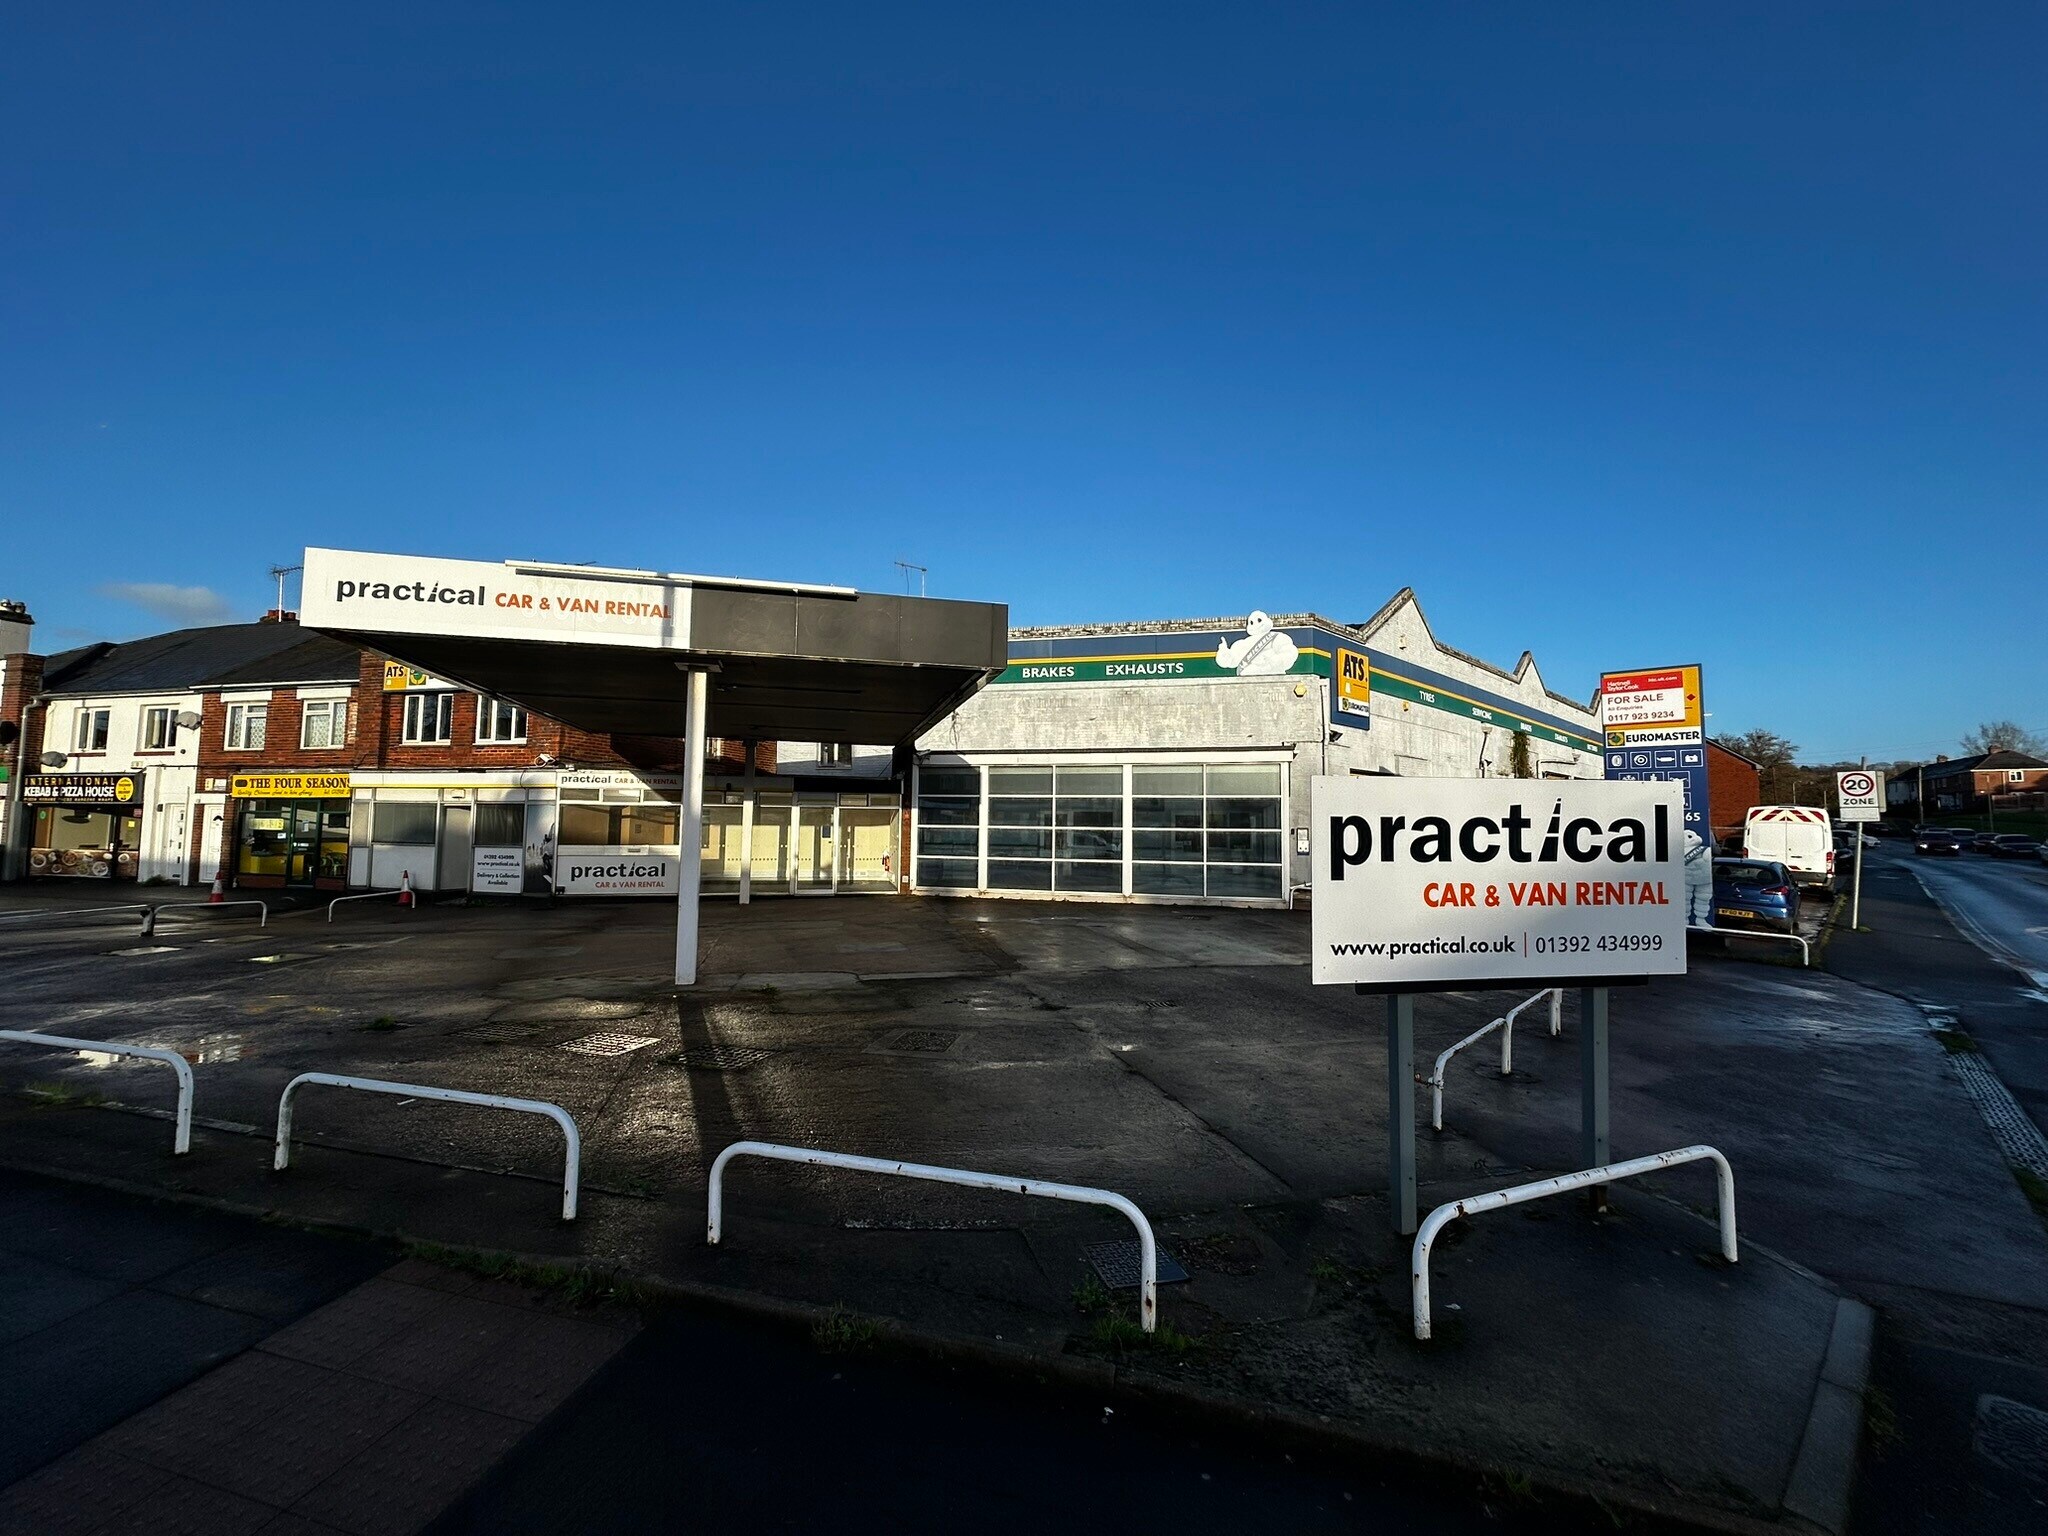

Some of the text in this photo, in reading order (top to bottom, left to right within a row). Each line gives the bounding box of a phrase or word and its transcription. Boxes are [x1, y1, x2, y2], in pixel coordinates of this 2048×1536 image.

[336, 579, 672, 620] practical CAR & VAN RENTAL
[1022, 662, 1185, 679] BRAKES EXHAUSTS
[1419, 690, 1436, 704] TYRES
[1607, 693, 1665, 705] FOR SALE
[1608, 710, 1675, 722] 0117 923 9234
[1626, 731, 1700, 743] EUROMASTER
[24, 777, 115, 786] INTERNATIONAL
[249, 778, 271, 788] THE
[274, 777, 300, 788] FOUR
[561, 775, 611, 785] practical
[1845, 779, 1870, 790] 20
[24, 786, 51, 797] KEBAB
[52, 786, 59, 797] &
[60, 786, 84, 797] PIZZA
[85, 786, 114, 797] HOUSE
[1843, 798, 1875, 806] ZONE
[1329, 797, 1669, 881] practical
[571, 862, 665, 881] practical
[595, 881, 610, 889] CAR
[1423, 881, 1669, 908] CAR & VAN RENTAL
[1330, 934, 1663, 960] www.practical.co.uk 01392 434999
